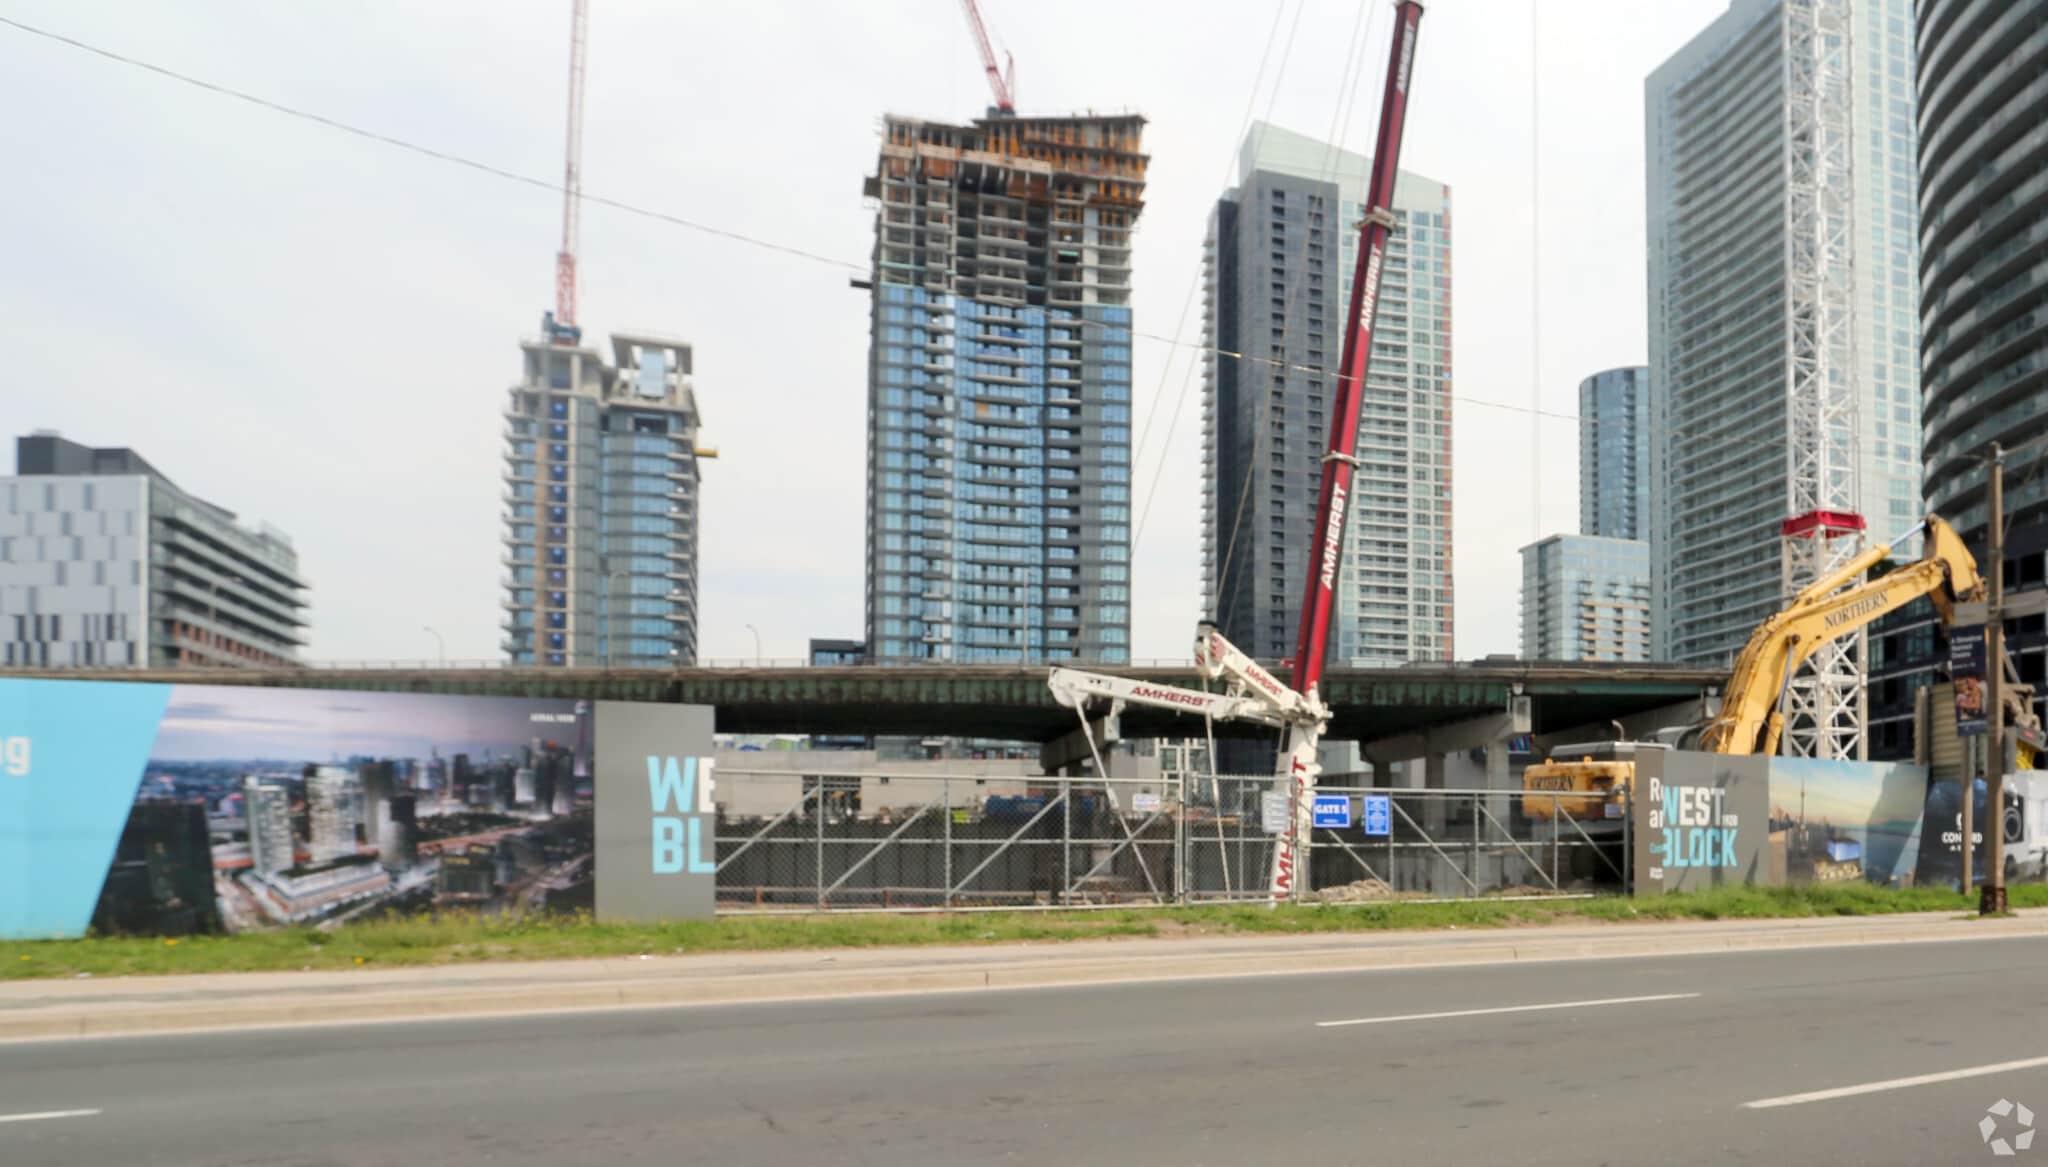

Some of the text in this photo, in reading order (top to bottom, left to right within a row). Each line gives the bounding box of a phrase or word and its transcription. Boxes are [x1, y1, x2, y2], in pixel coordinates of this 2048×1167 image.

[1361, 243, 1382, 331] AMHERST
[1321, 482, 1347, 590] AMHERST
[1823, 591, 1888, 631] NORTHERN
[1130, 686, 1215, 706] AMHERST
[1244, 664, 1283, 696] AMHERST
[1314, 804, 1339, 815] GATE
